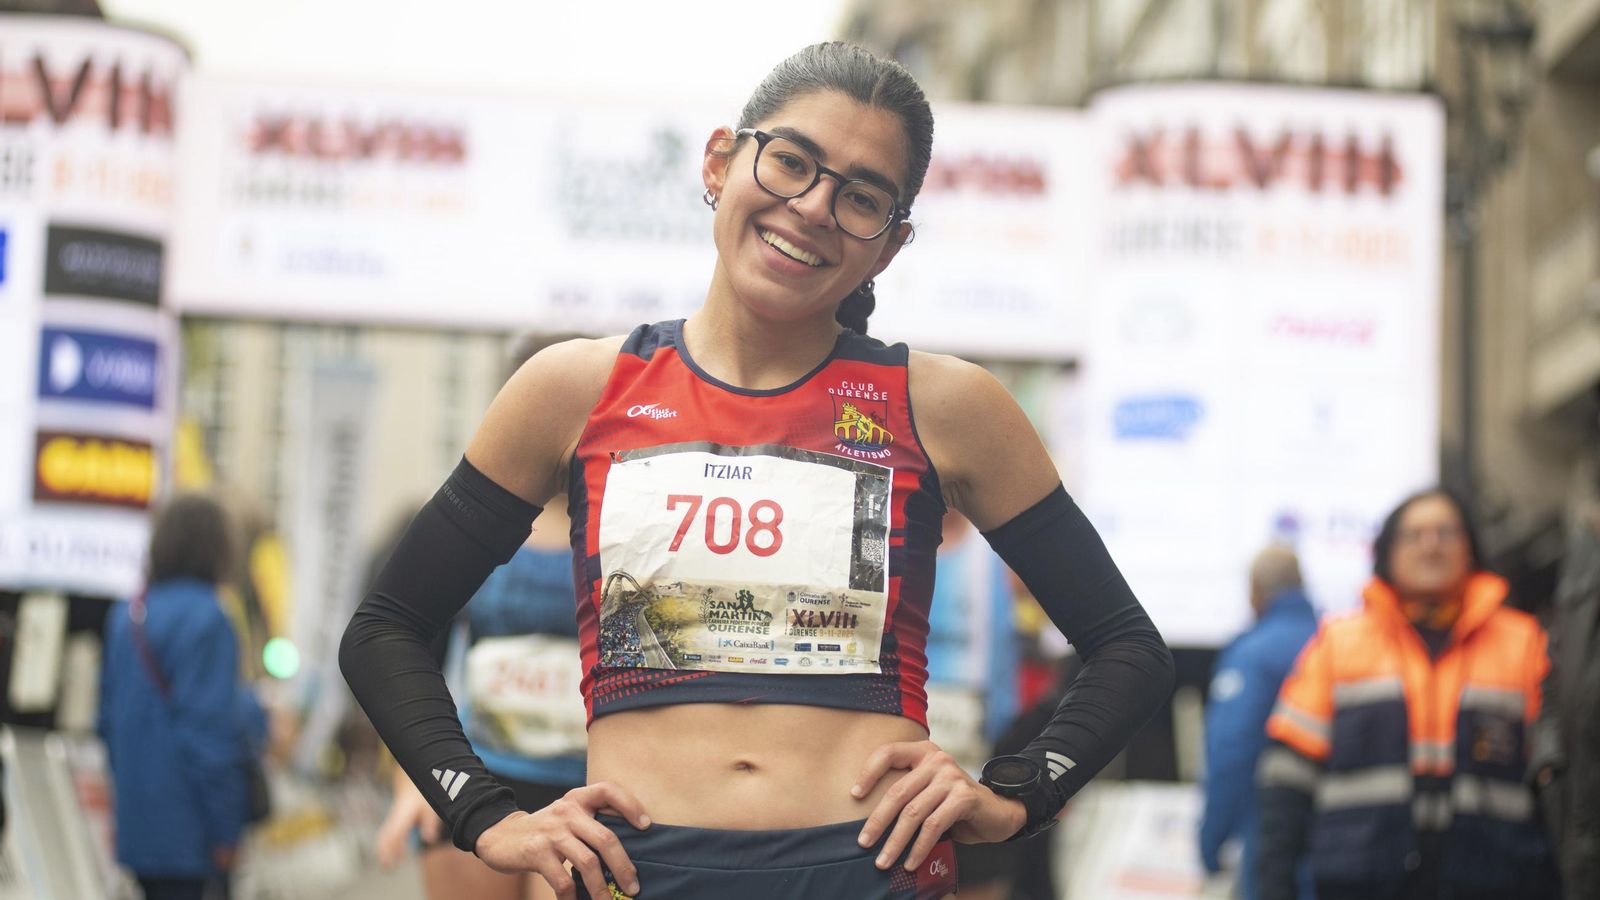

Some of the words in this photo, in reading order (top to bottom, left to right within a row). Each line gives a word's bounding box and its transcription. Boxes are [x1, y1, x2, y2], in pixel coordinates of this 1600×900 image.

[842, 381, 874, 392] CLUB
[828, 387, 888, 401] OURENSE
[835, 443, 892, 459] ATLETISMO
[704, 463, 753, 480] ITZIAR
[666, 494, 784, 557] 708
[709, 600, 736, 610] SAN
[708, 624, 770, 635] OURENSE
[733, 640, 770, 649] CaixaBank
